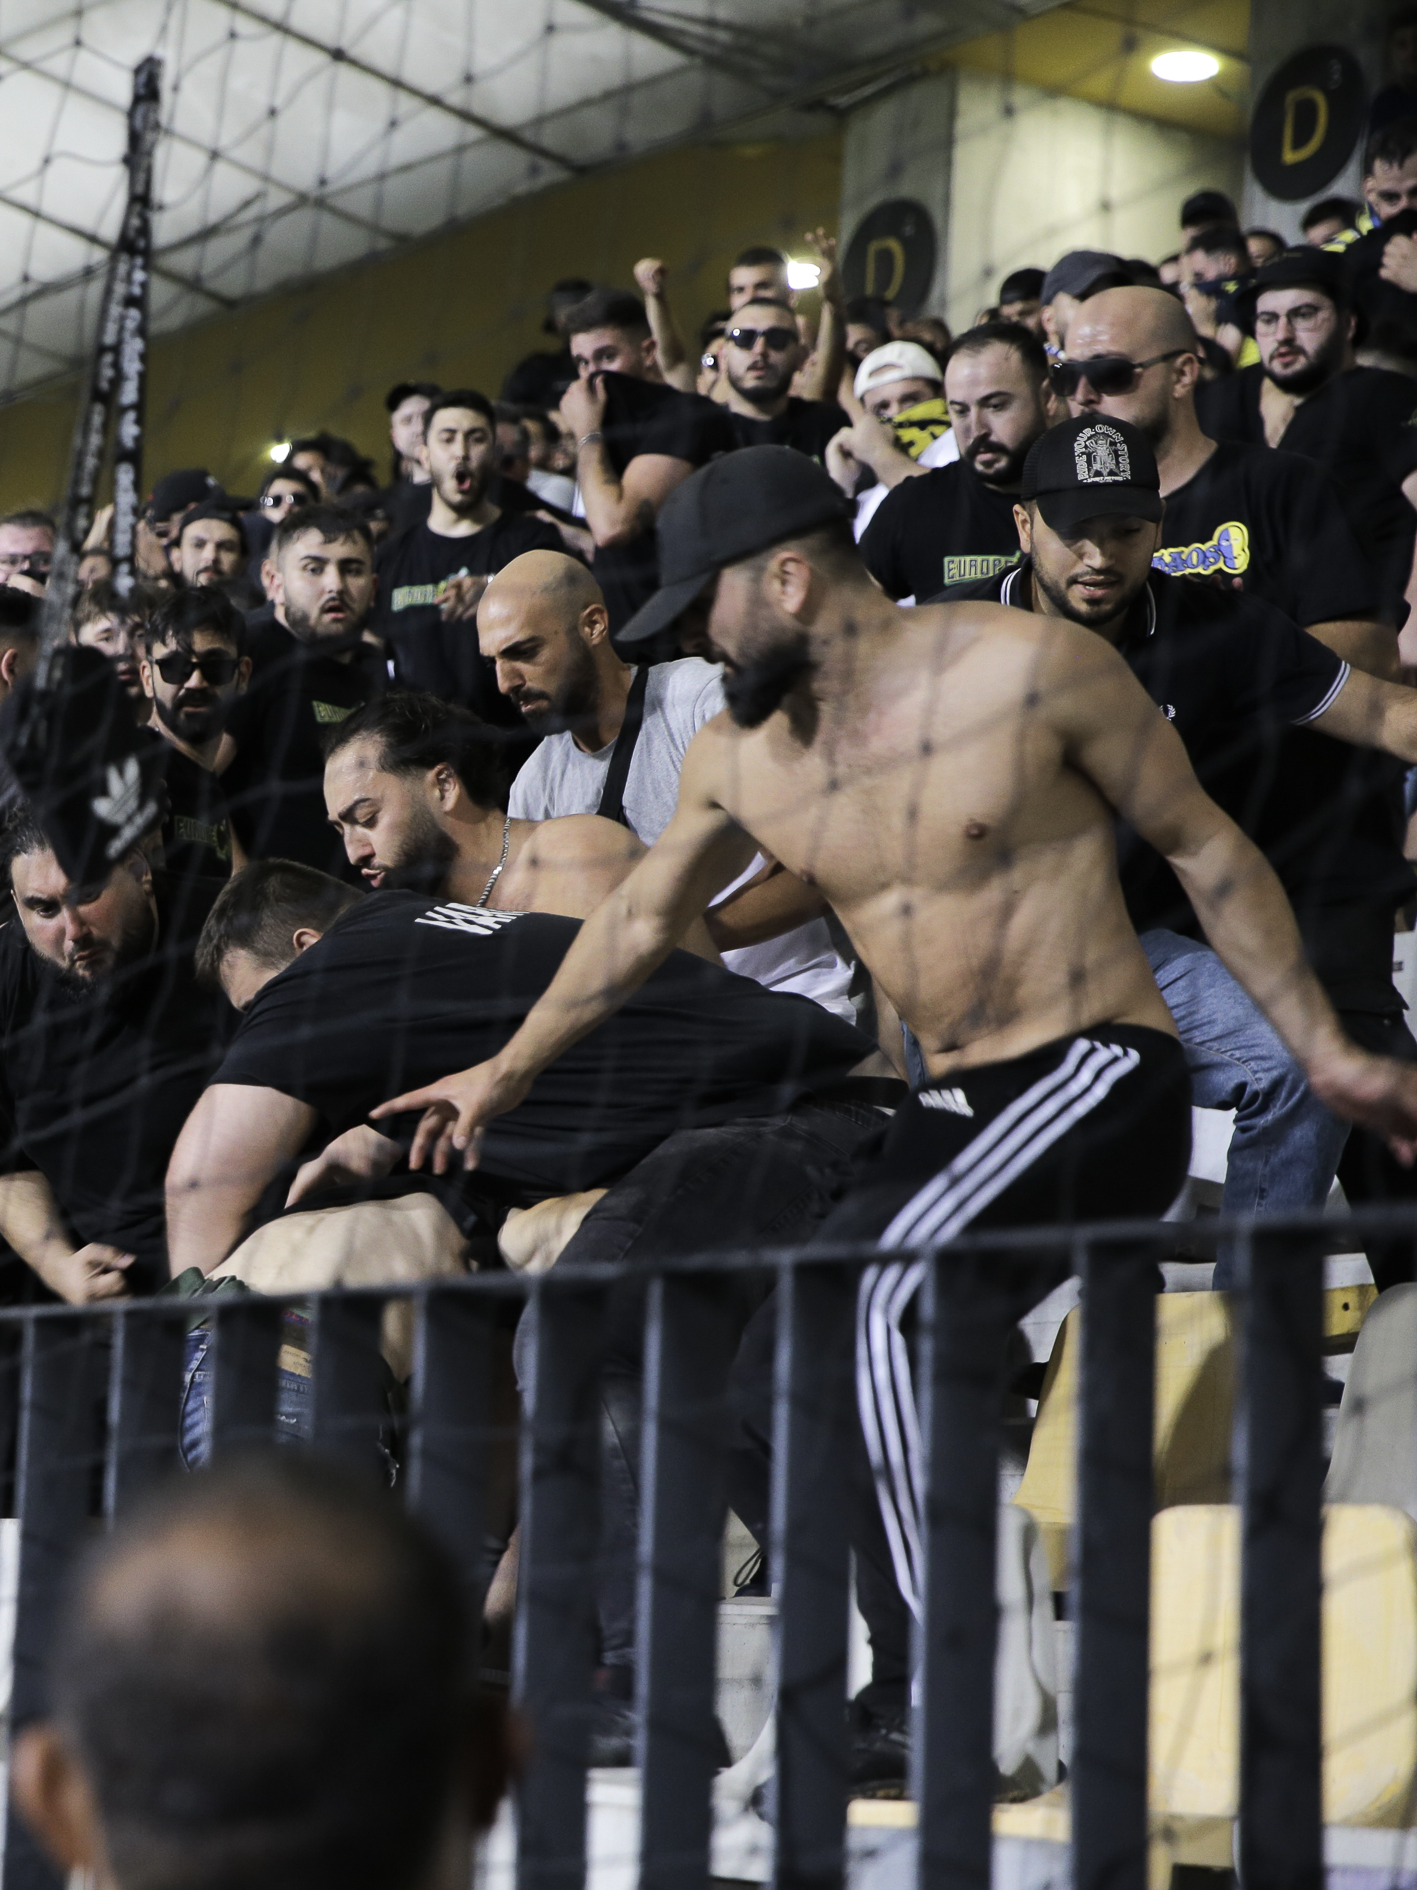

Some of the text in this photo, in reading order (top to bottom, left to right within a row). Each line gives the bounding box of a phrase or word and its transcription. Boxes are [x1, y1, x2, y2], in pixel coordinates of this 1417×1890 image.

[1281, 84, 1330, 166] D
[865, 236, 906, 301] D
[1073, 424, 1131, 481] RIDE YOUR OWN STORY
[1152, 544, 1221, 574] HAOS
